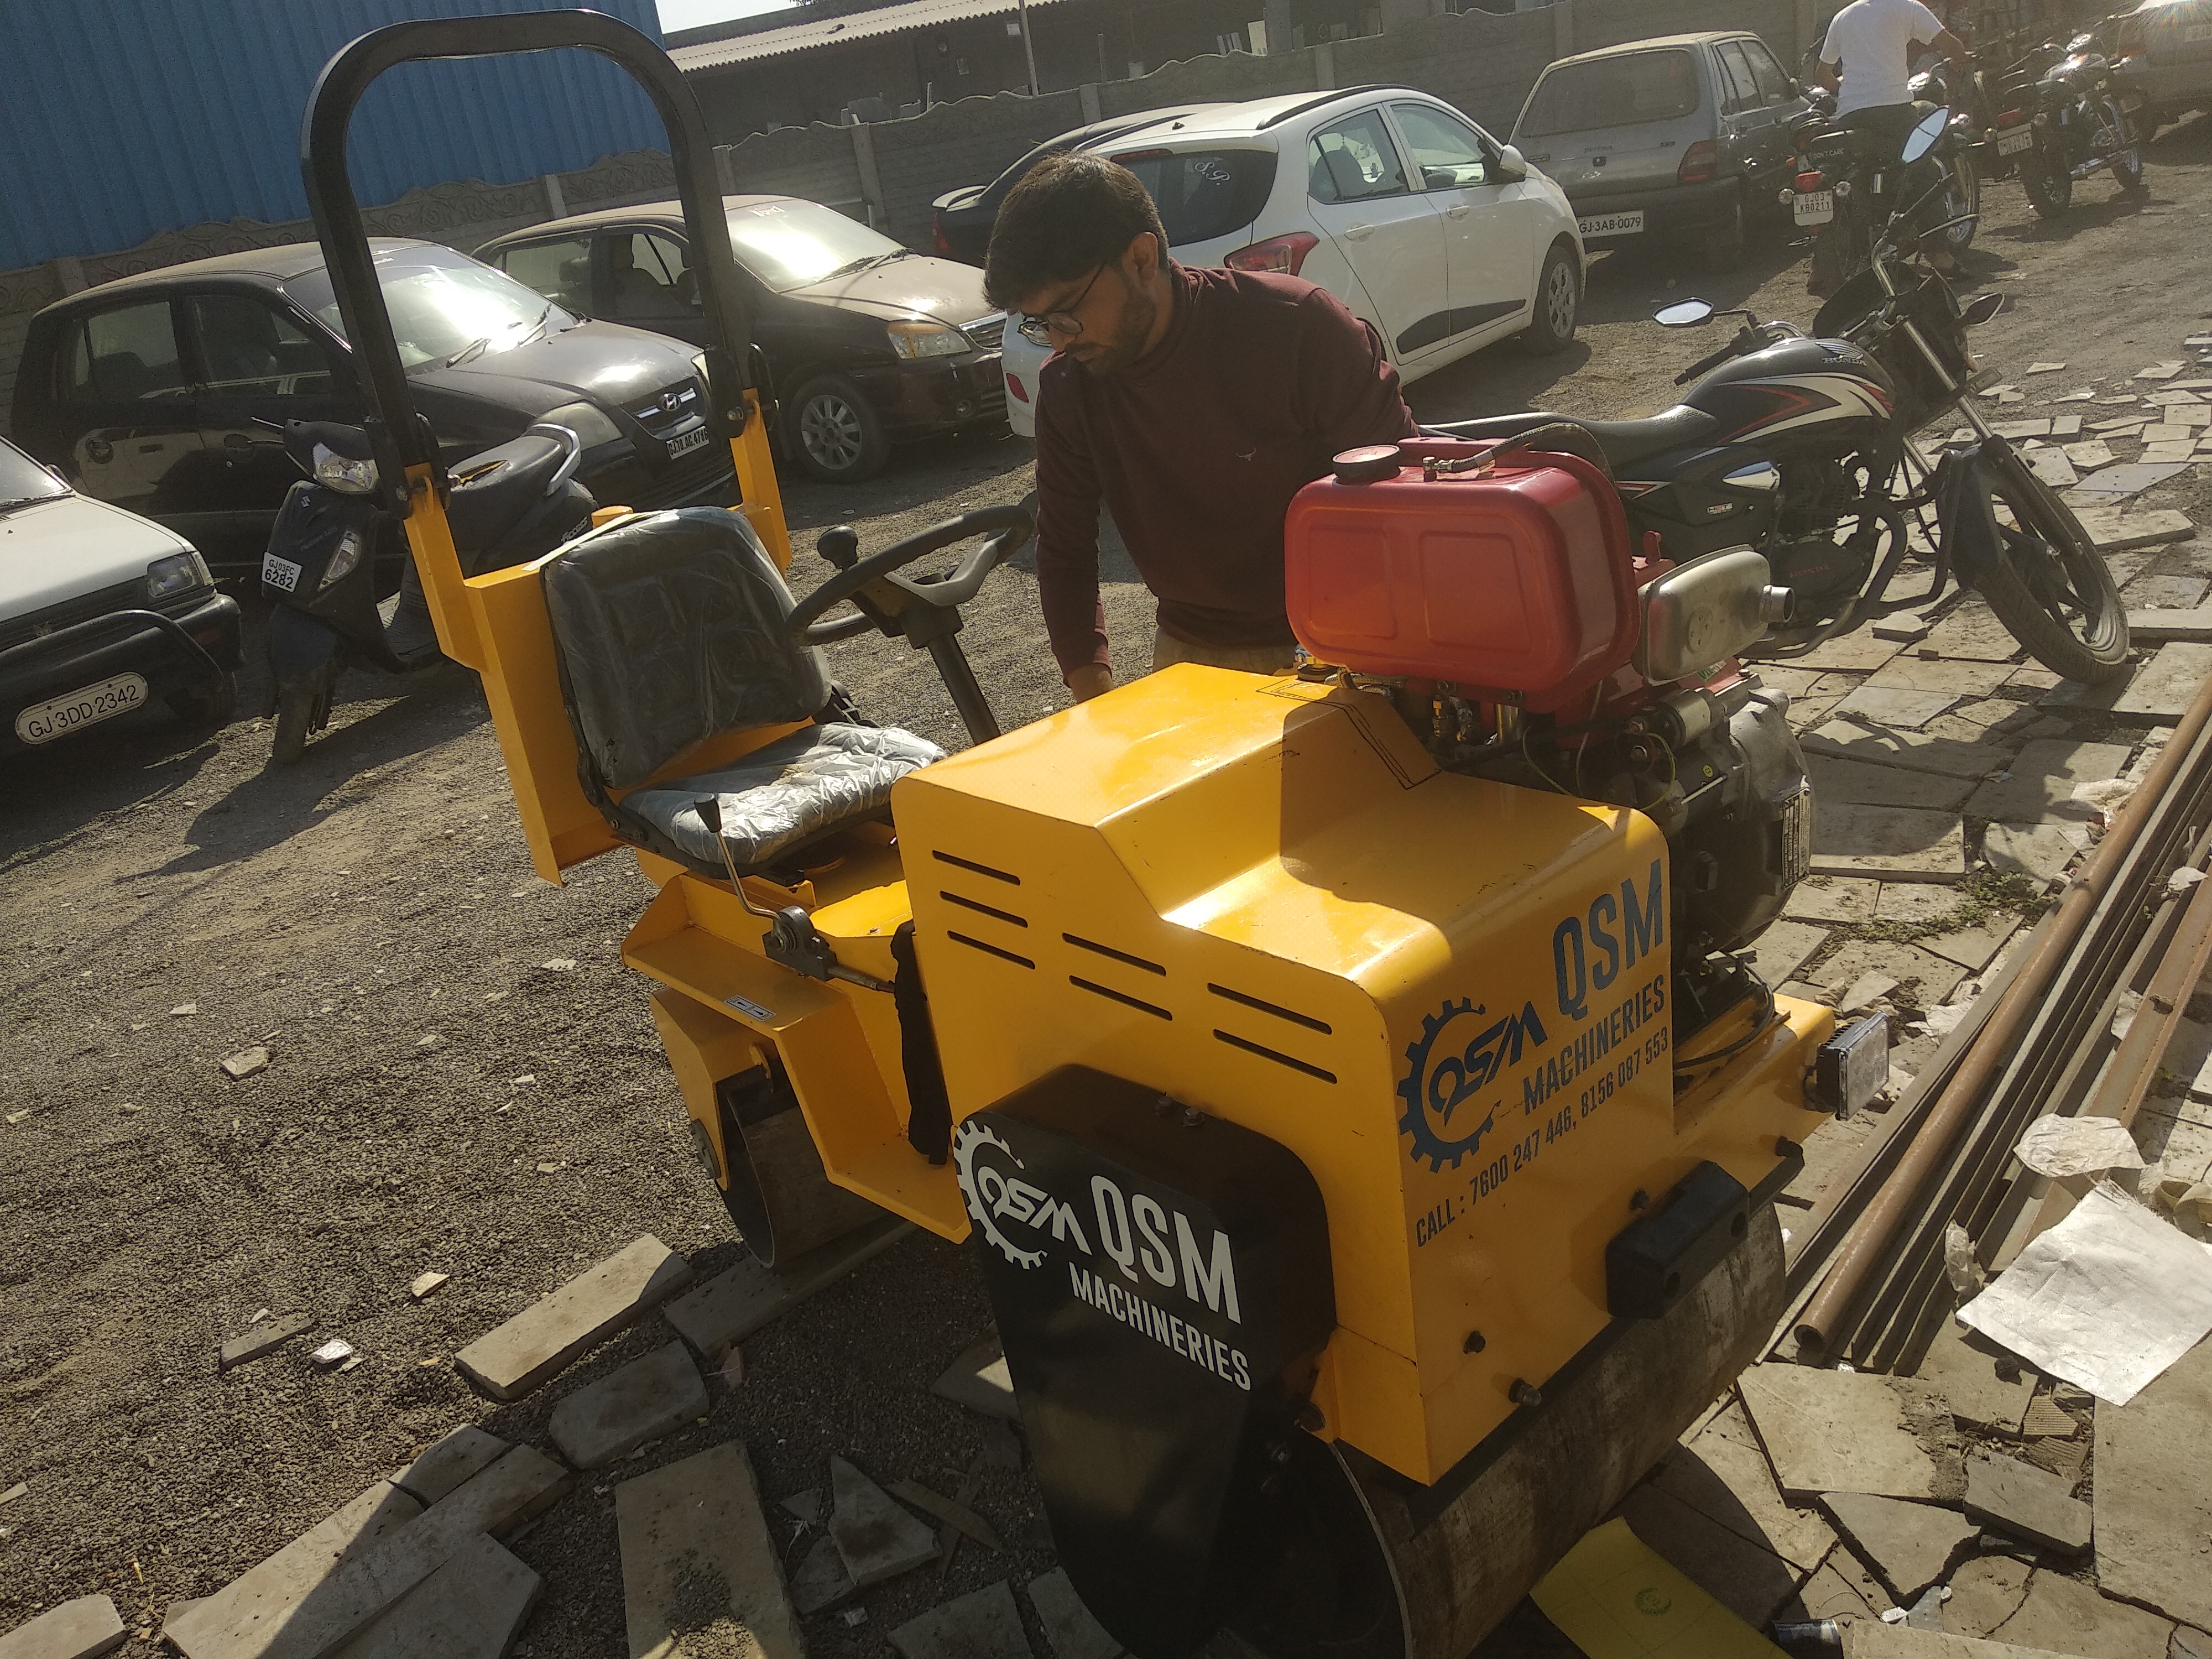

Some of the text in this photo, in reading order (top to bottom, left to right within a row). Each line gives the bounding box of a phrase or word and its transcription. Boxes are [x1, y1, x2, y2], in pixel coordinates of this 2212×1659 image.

[1800, 201, 1830, 213] KB0211
[1804, 193, 1825, 203] GJ03
[1822, 357, 1867, 367] HONDA
[264, 568, 294, 589] 6282
[268, 559, 295, 576] GJ03FC
[1552, 858, 1664, 1021] QSM
[1522, 974, 1665, 1116] MACHINERIES
[1416, 1198, 1456, 1248] CALL
[1469, 1154, 1509, 1206] 7600
[1513, 1129, 1540, 1173] 247
[1545, 1105, 1577, 1145] 446,
[1580, 1071, 1614, 1119] 8156
[1617, 1047, 1641, 1088] 087
[1645, 1025, 1668, 1065] 553
[1090, 1174, 1242, 1325] QSM
[1068, 1260, 1252, 1391] MACHINERIES
